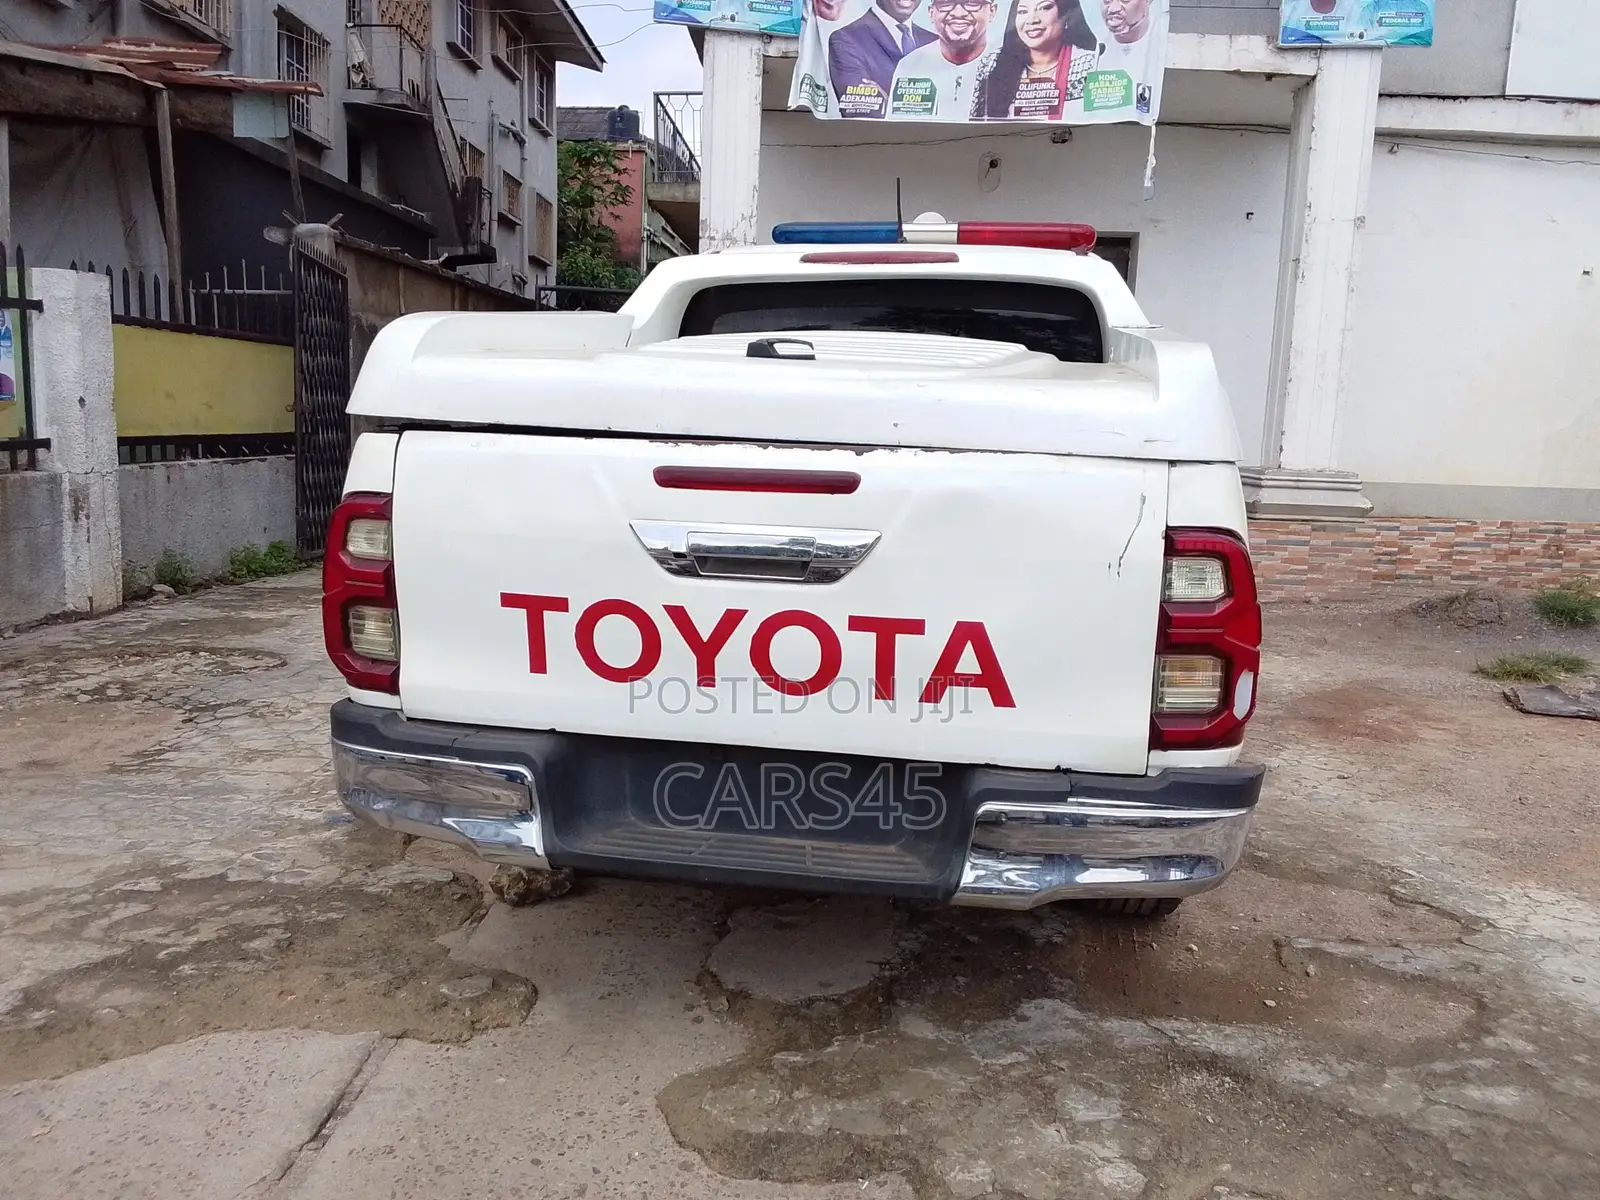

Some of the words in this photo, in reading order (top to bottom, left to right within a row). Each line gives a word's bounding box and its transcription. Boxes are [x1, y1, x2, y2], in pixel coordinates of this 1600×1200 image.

[752, 3, 778, 11] FEDERAL
[1019, 82, 1055, 90] OLUFUNKE
[846, 86, 878, 95] BIMBO
[1016, 90, 1059, 98] COMFORTER
[1091, 86, 1124, 95] GABRIEL
[902, 94, 922, 102] DON
[500, 591, 1017, 709] TOYOTA
